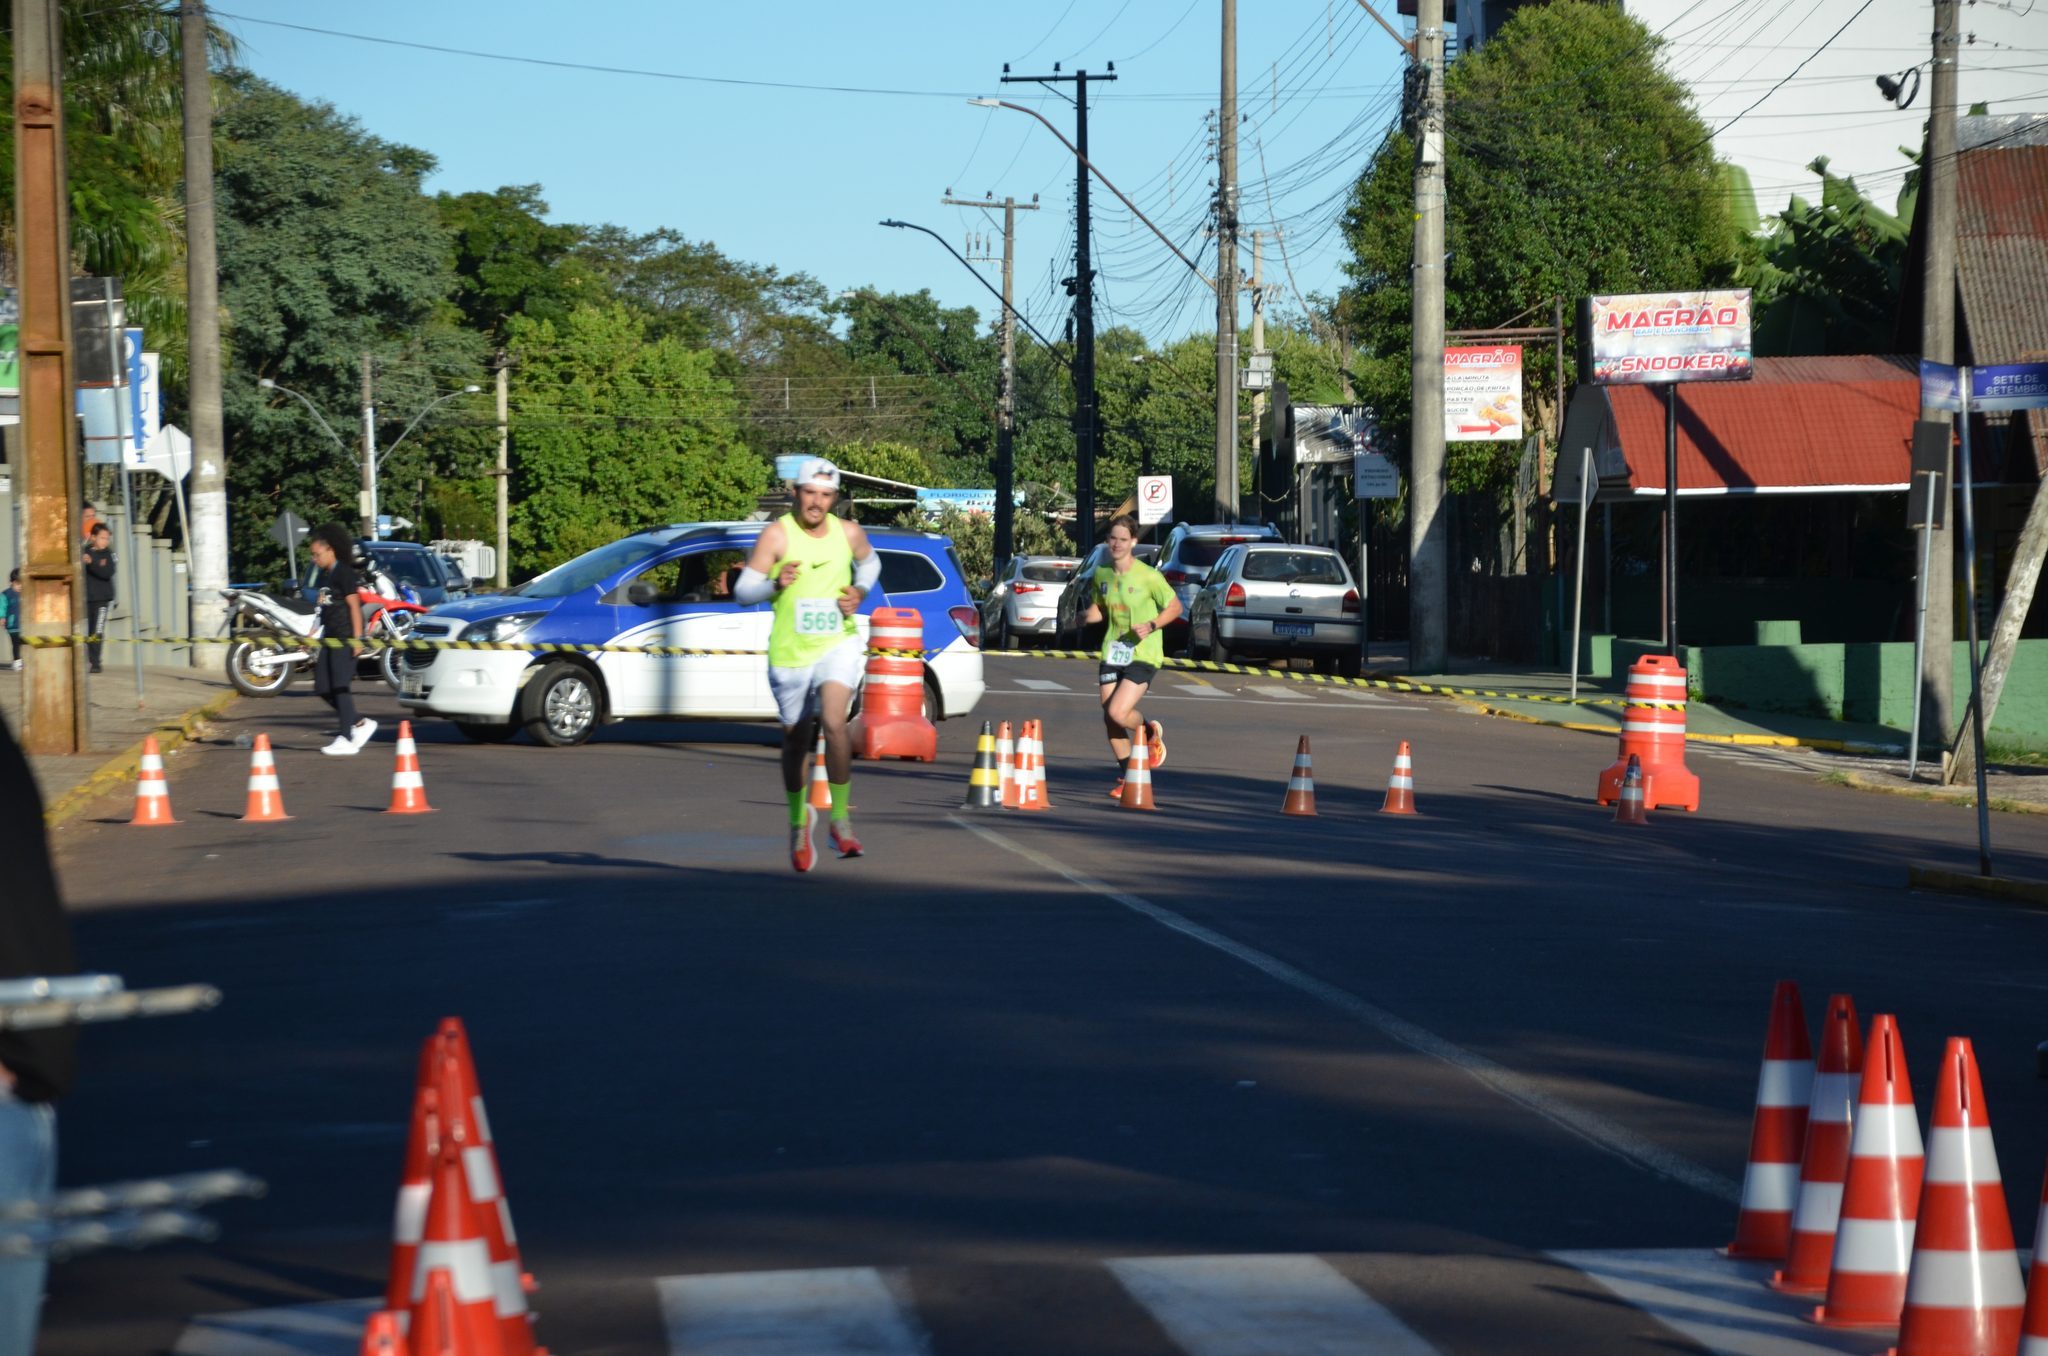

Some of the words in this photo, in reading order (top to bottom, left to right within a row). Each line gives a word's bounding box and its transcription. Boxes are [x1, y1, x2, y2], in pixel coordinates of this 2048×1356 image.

[1607, 302, 1738, 330] MAGRÃO
[1445, 350, 1516, 365] MAGRÃO
[1621, 355, 1727, 371] SNOOKER
[1993, 375, 2022, 385] SETE
[2024, 374, 2040, 384] DE
[1985, 384, 2047, 395] SETEMBRO
[803, 611, 838, 630] 569
[1112, 649, 1131, 663] 479
